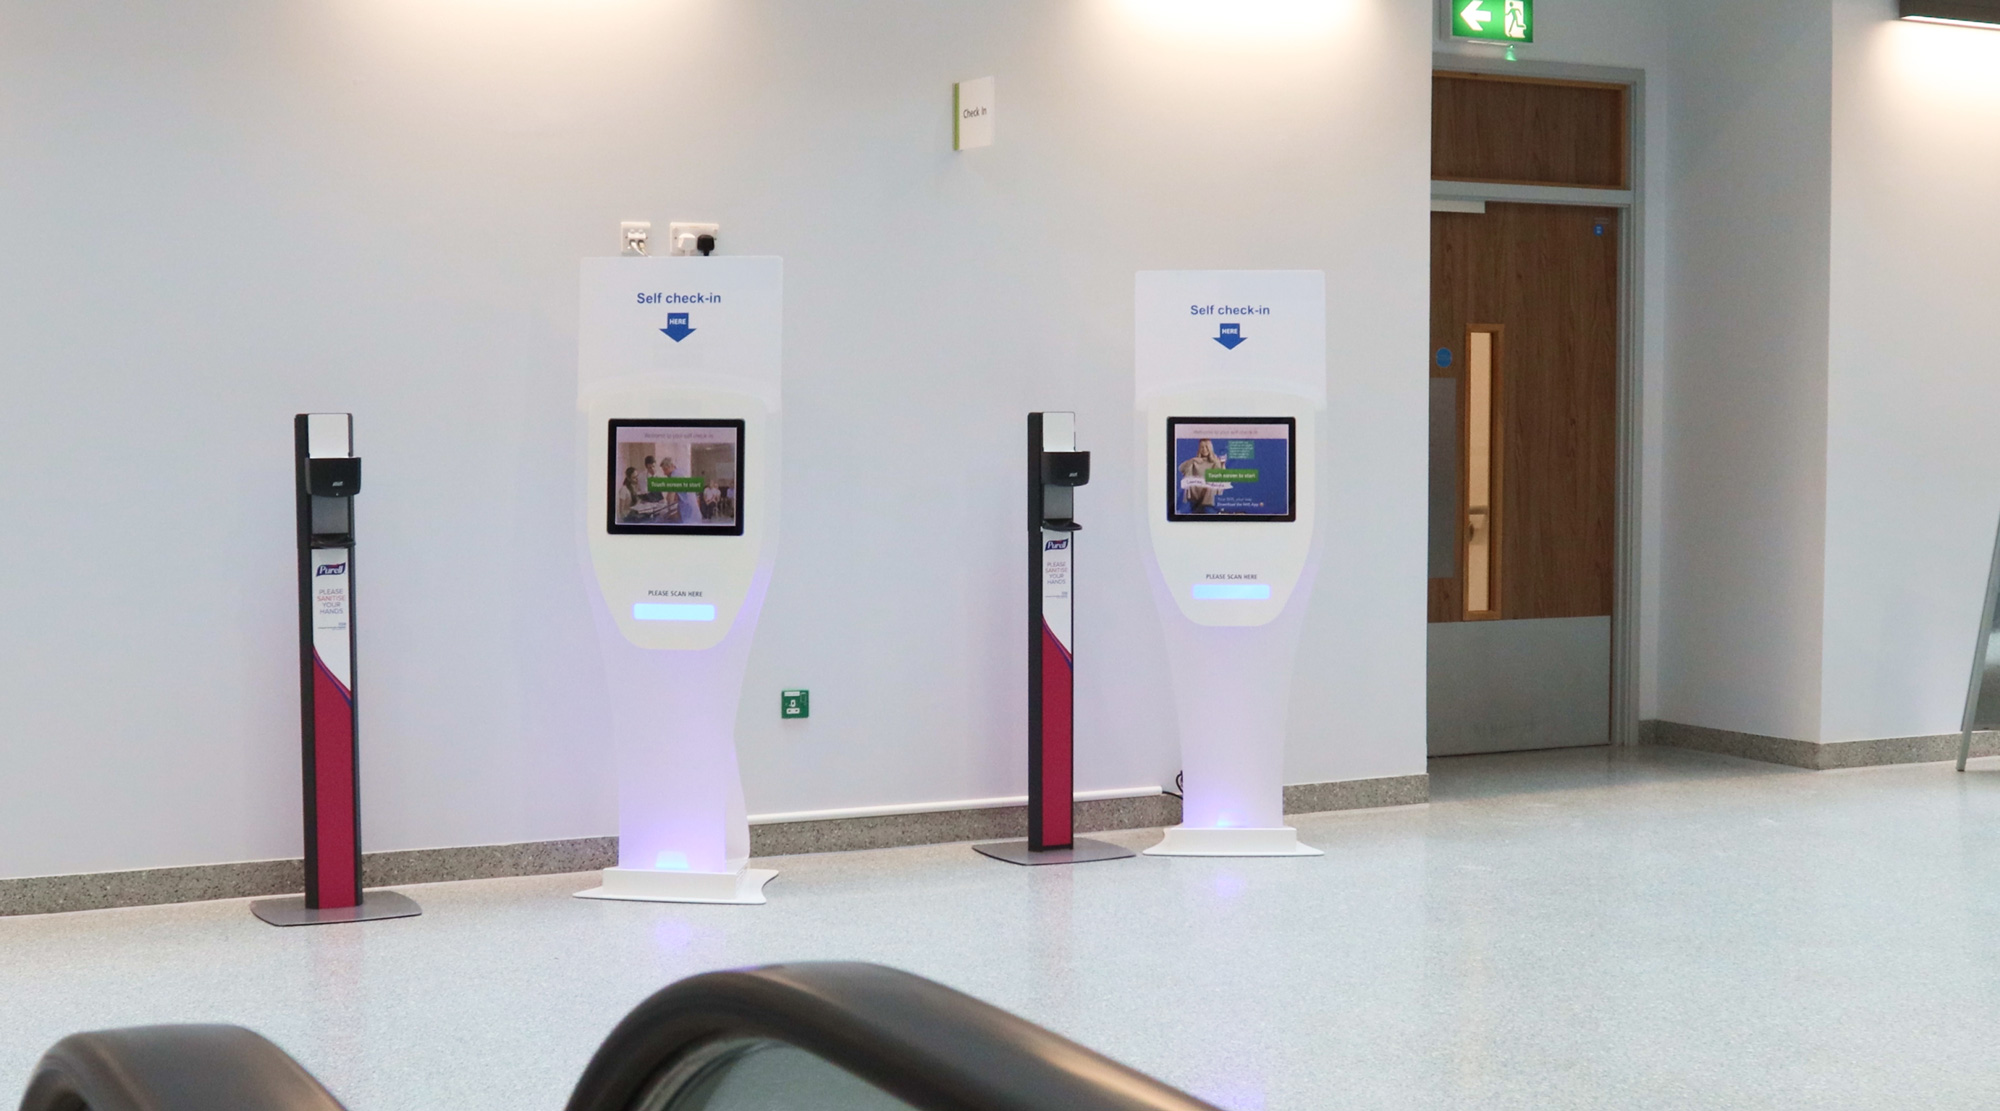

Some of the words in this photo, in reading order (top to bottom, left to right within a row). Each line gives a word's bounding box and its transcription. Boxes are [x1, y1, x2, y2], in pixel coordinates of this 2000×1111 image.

[963, 107, 979, 118] Check
[981, 106, 987, 115] In
[637, 292, 662, 304] Self
[665, 292, 721, 304] check-in
[1190, 304, 1214, 315] Self
[1218, 304, 1270, 315] check-in
[1047, 541, 1067, 549] Purell
[319, 565, 343, 575] Purell
